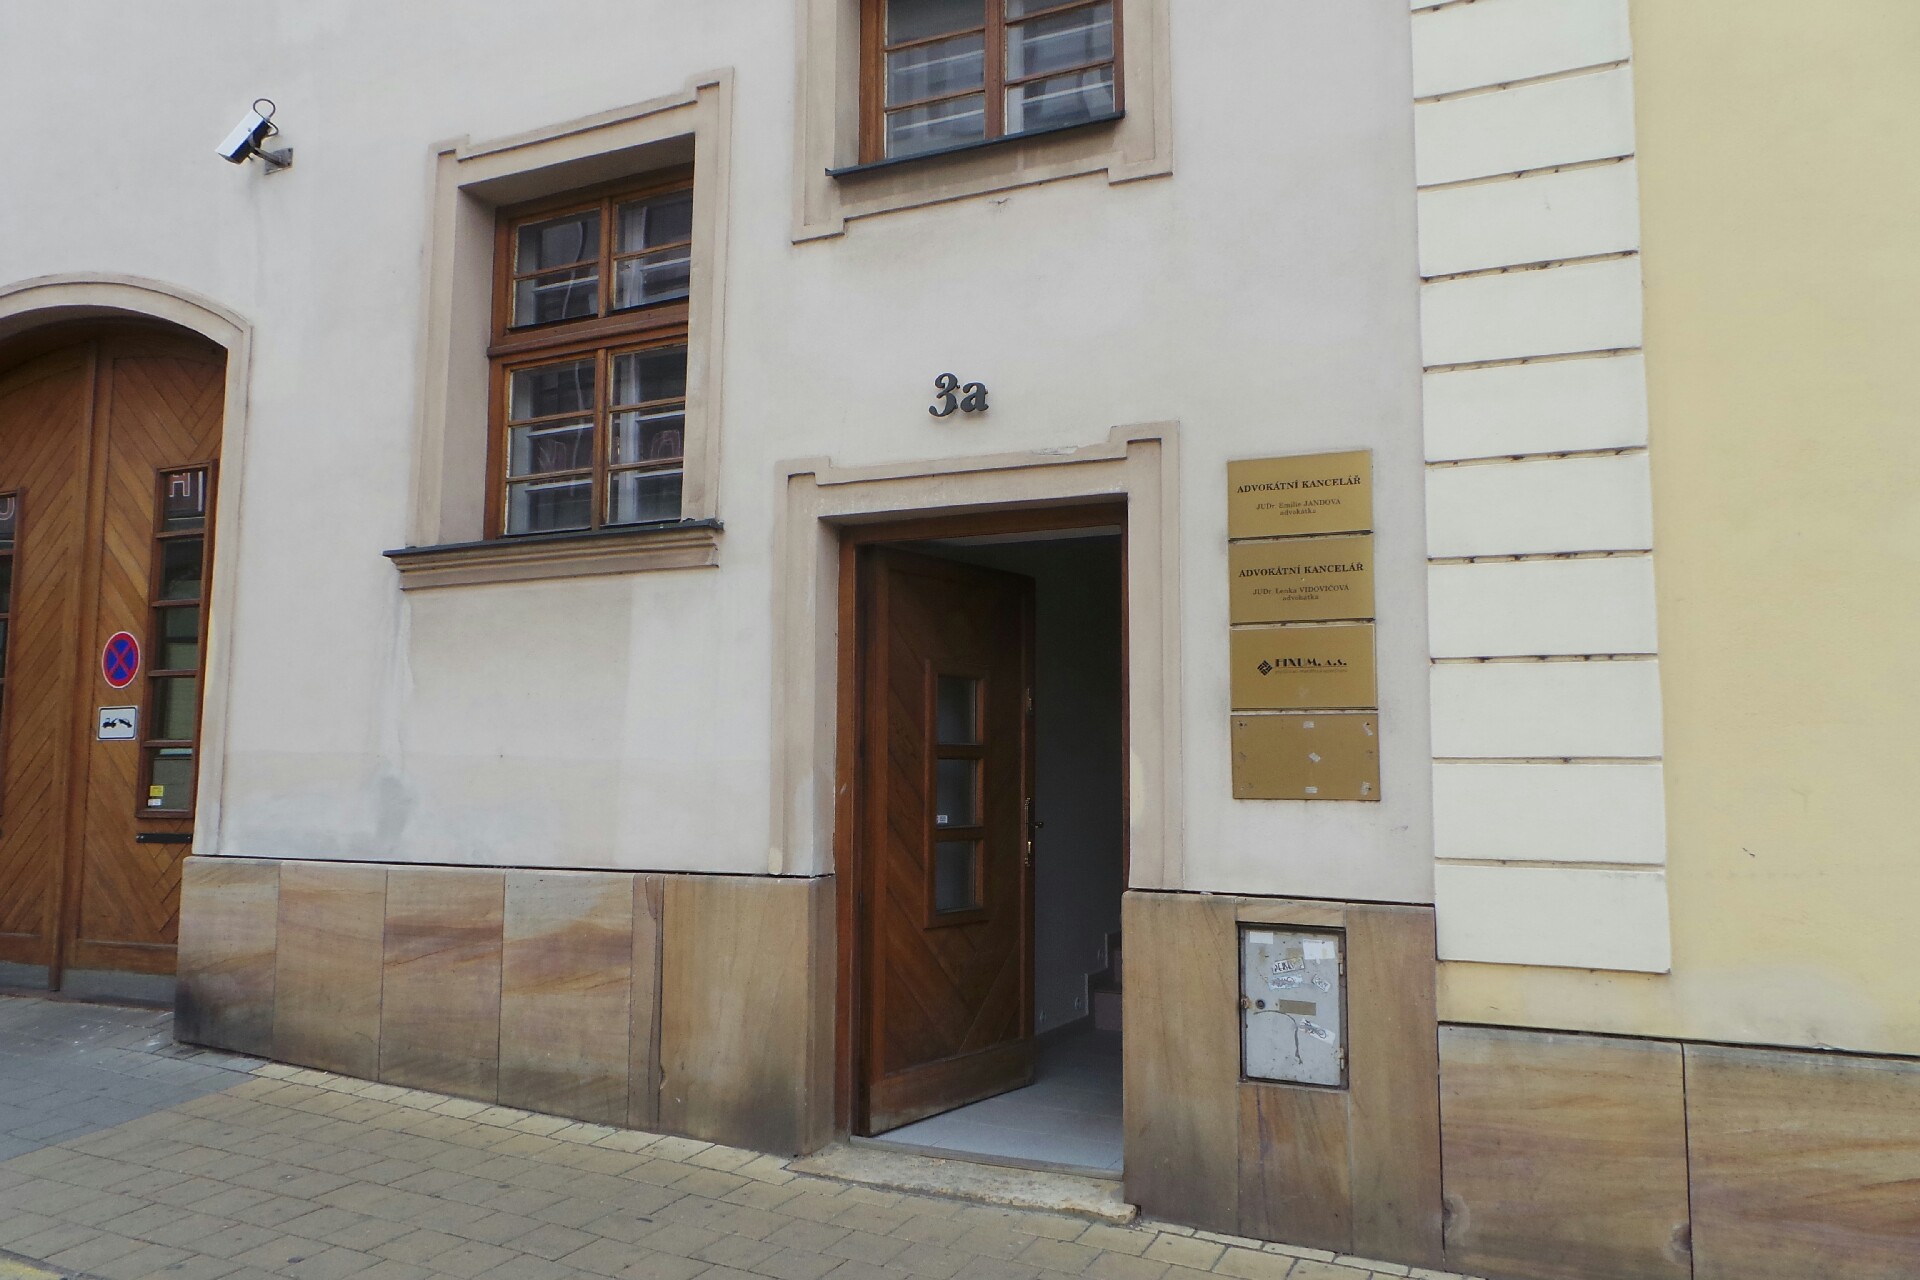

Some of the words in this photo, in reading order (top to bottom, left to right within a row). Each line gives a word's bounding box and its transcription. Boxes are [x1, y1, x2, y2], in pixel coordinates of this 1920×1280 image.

[928, 372, 989, 417] 3a
[1237, 480, 1299, 493] ADVOKÁTNÍ
[1302, 475, 1361, 489] KANCELÁŘ
[1238, 565, 1301, 577] ADVOKÁTNÍ
[1304, 561, 1364, 574] KANCELÁŘ
